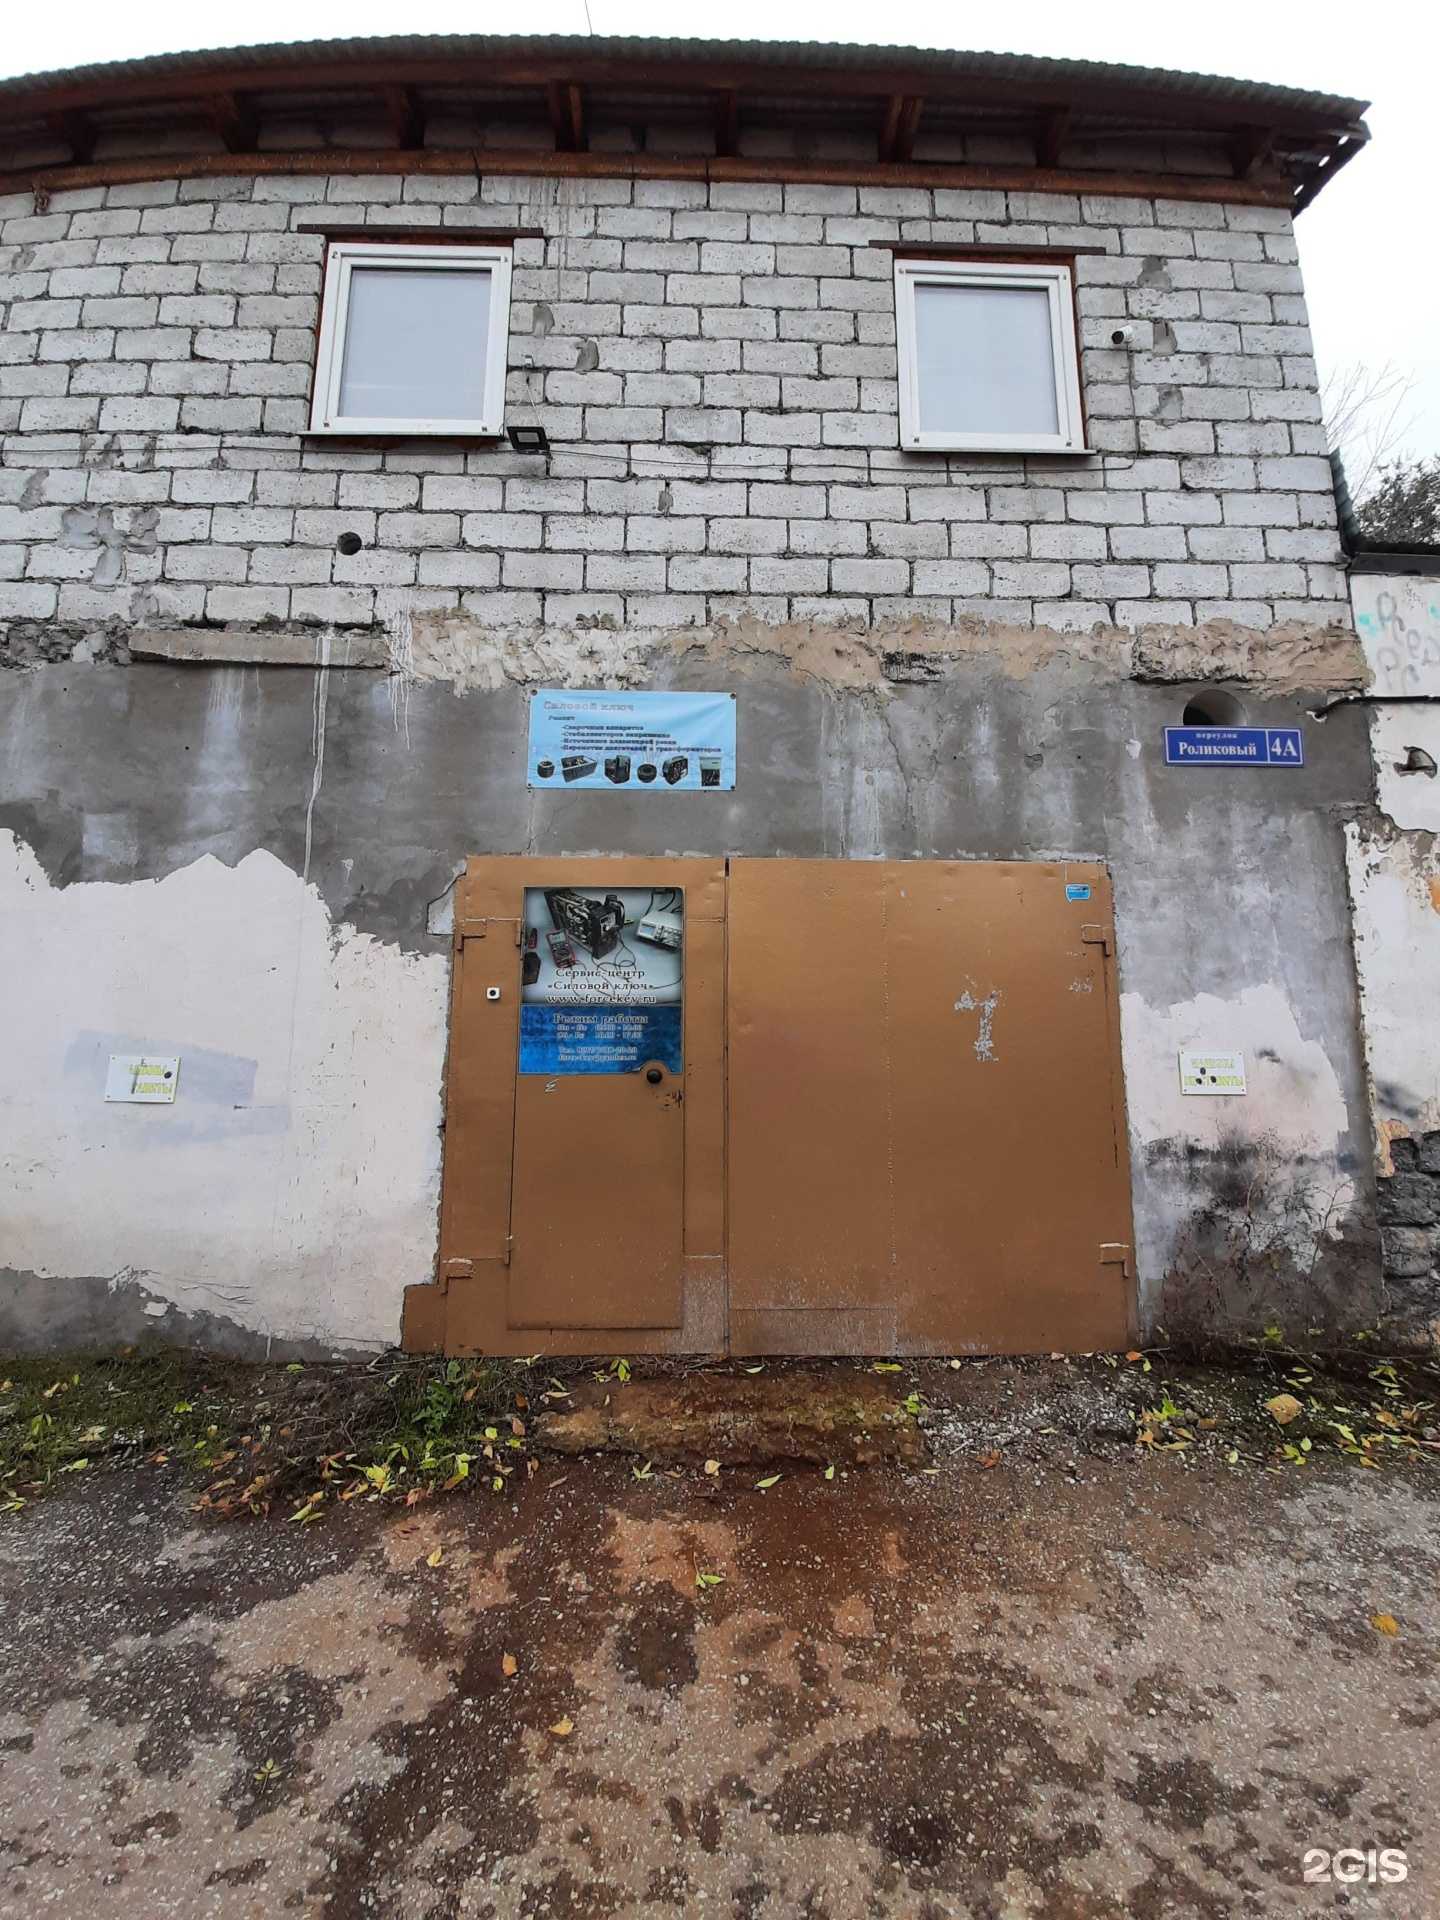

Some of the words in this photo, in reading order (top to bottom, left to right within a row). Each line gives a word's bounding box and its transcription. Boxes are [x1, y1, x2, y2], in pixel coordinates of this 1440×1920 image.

[1179, 742, 1257, 756] Роликовый
[548, 980, 610, 990] «Силовой
[614, 982, 654, 991] ключ»
[552, 1013, 598, 1024] Режим
[600, 1013, 649, 1025] работы
